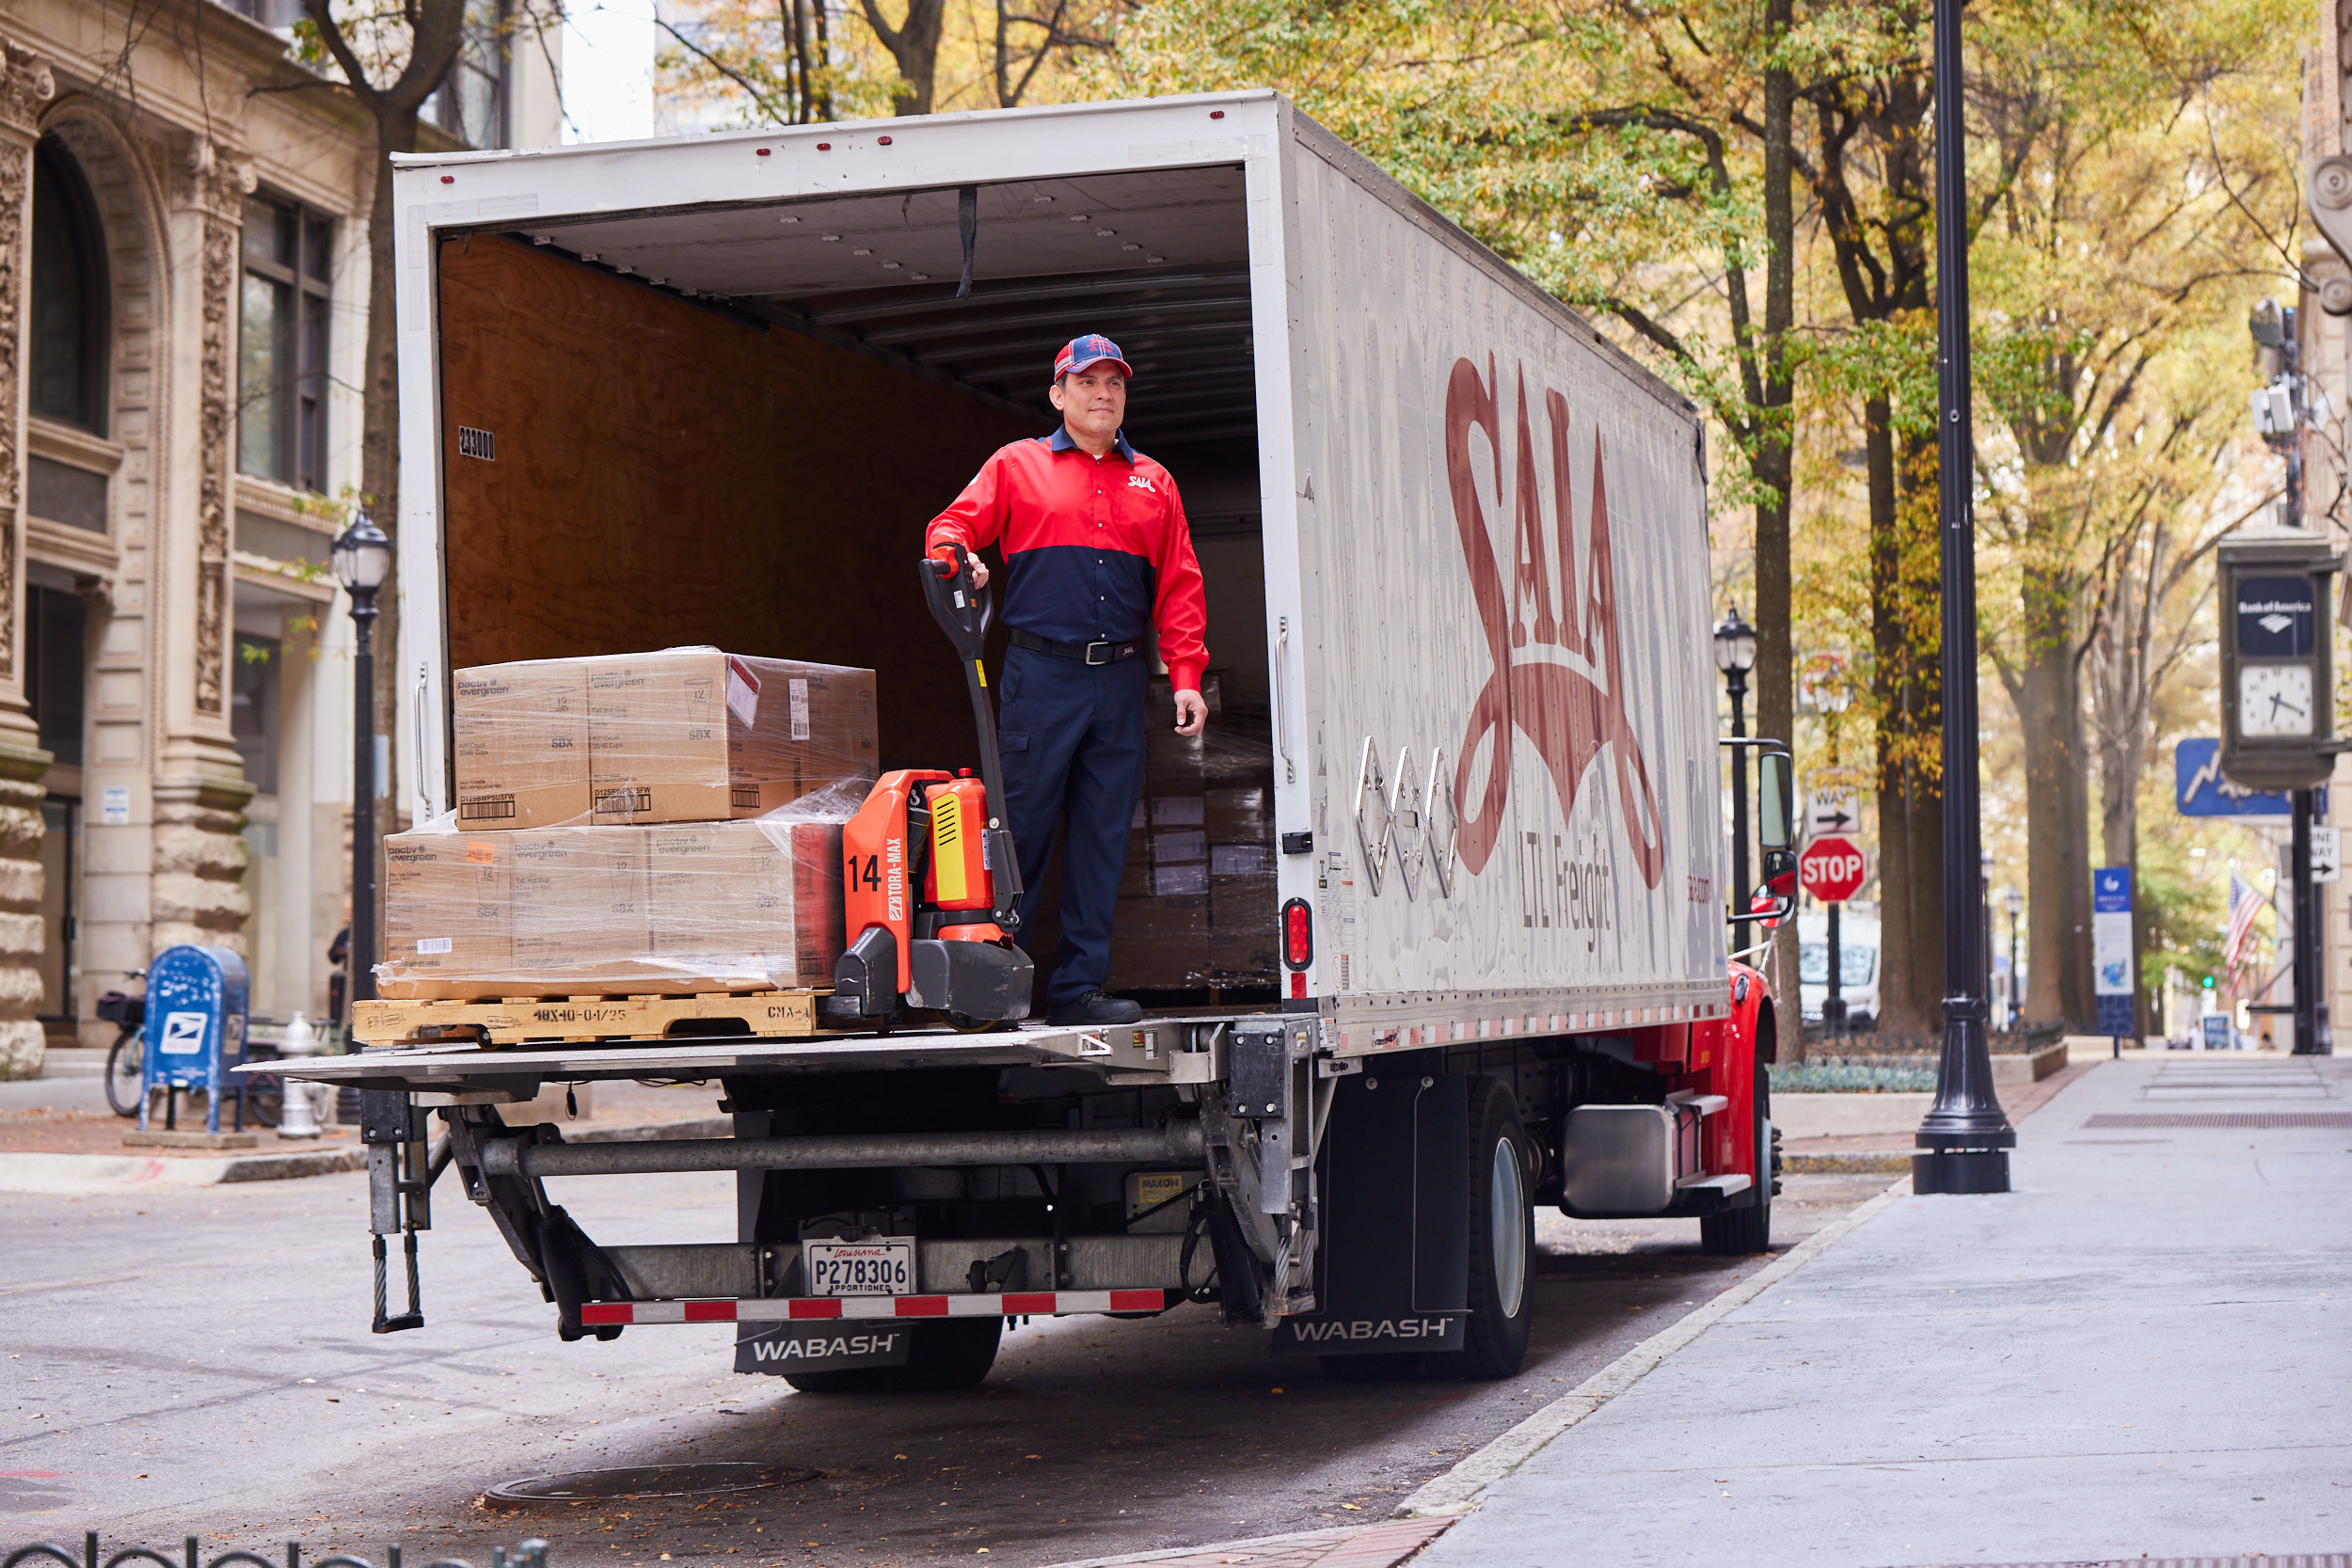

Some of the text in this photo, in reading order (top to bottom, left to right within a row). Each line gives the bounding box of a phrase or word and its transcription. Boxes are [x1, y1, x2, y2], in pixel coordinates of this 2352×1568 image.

[460, 427, 494, 460] 233000
[1128, 476, 1155, 493] SAIA
[2238, 601, 2264, 613] Bank
[2274, 600, 2312, 612] America
[1446, 349, 1664, 891] SAIA
[458, 680, 487, 689] pactiv
[594, 678, 644, 689] evergreen
[460, 687, 509, 696] evergreen
[694, 689, 705, 699] 12
[557, 697, 567, 707] 12
[689, 730, 711, 740] SBX
[551, 737, 573, 748] SBX
[460, 793, 516, 802] D12SBWPSUSFW
[515, 842, 545, 851] pactiv
[656, 837, 689, 847] pactiv
[389, 846, 417, 855] pactiv
[516, 849, 567, 860] evergreen
[659, 845, 710, 854] evergreen
[391, 853, 437, 863] evergreen
[762, 857, 771, 866] 12
[886, 837, 901, 896] TORA-MAX
[1803, 855, 1861, 883] STOP
[482, 867, 493, 878] 12
[849, 855, 882, 892] 14
[1519, 831, 1610, 953] LTL Freight
[477, 908, 499, 918] SBX
[612, 903, 634, 913] SBX
[1142, 1179, 1179, 1188] MAXON
[834, 1247, 885, 1259] Louisiana
[816, 1259, 906, 1284] P278306
[645, 1307, 671, 1316] MAXON
